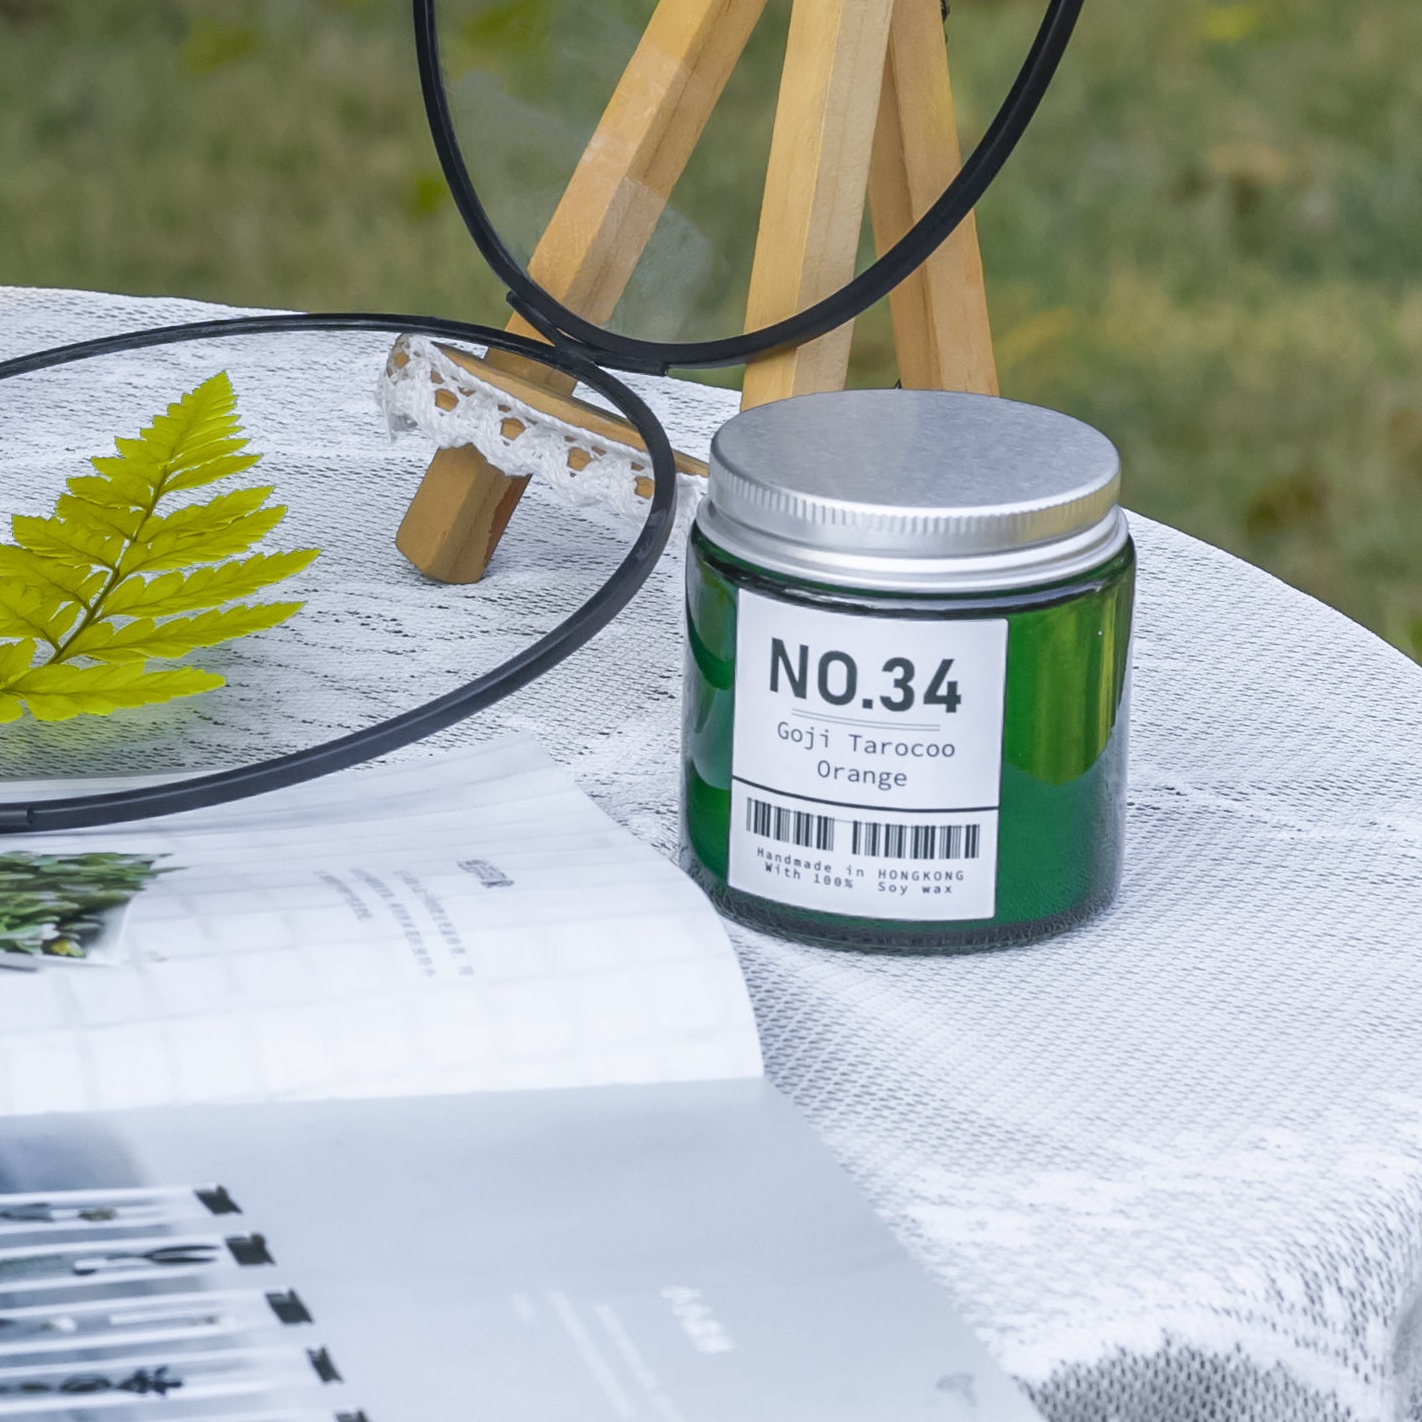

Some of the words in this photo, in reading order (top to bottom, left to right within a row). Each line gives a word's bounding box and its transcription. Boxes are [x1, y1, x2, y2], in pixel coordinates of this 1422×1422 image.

[769, 637, 962, 713] NO.34
[777, 721, 830, 751] Goji
[848, 733, 956, 758] Tarocoo
[817, 759, 908, 791] Orange
[757, 846, 833, 874] Handmade
[846, 865, 865, 878] in
[878, 869, 965, 881] HONGKONG
[765, 862, 801, 880] With
[813, 873, 854, 889] 100%
[878, 881, 909, 896] Soy
[922, 885, 953, 895] wax
